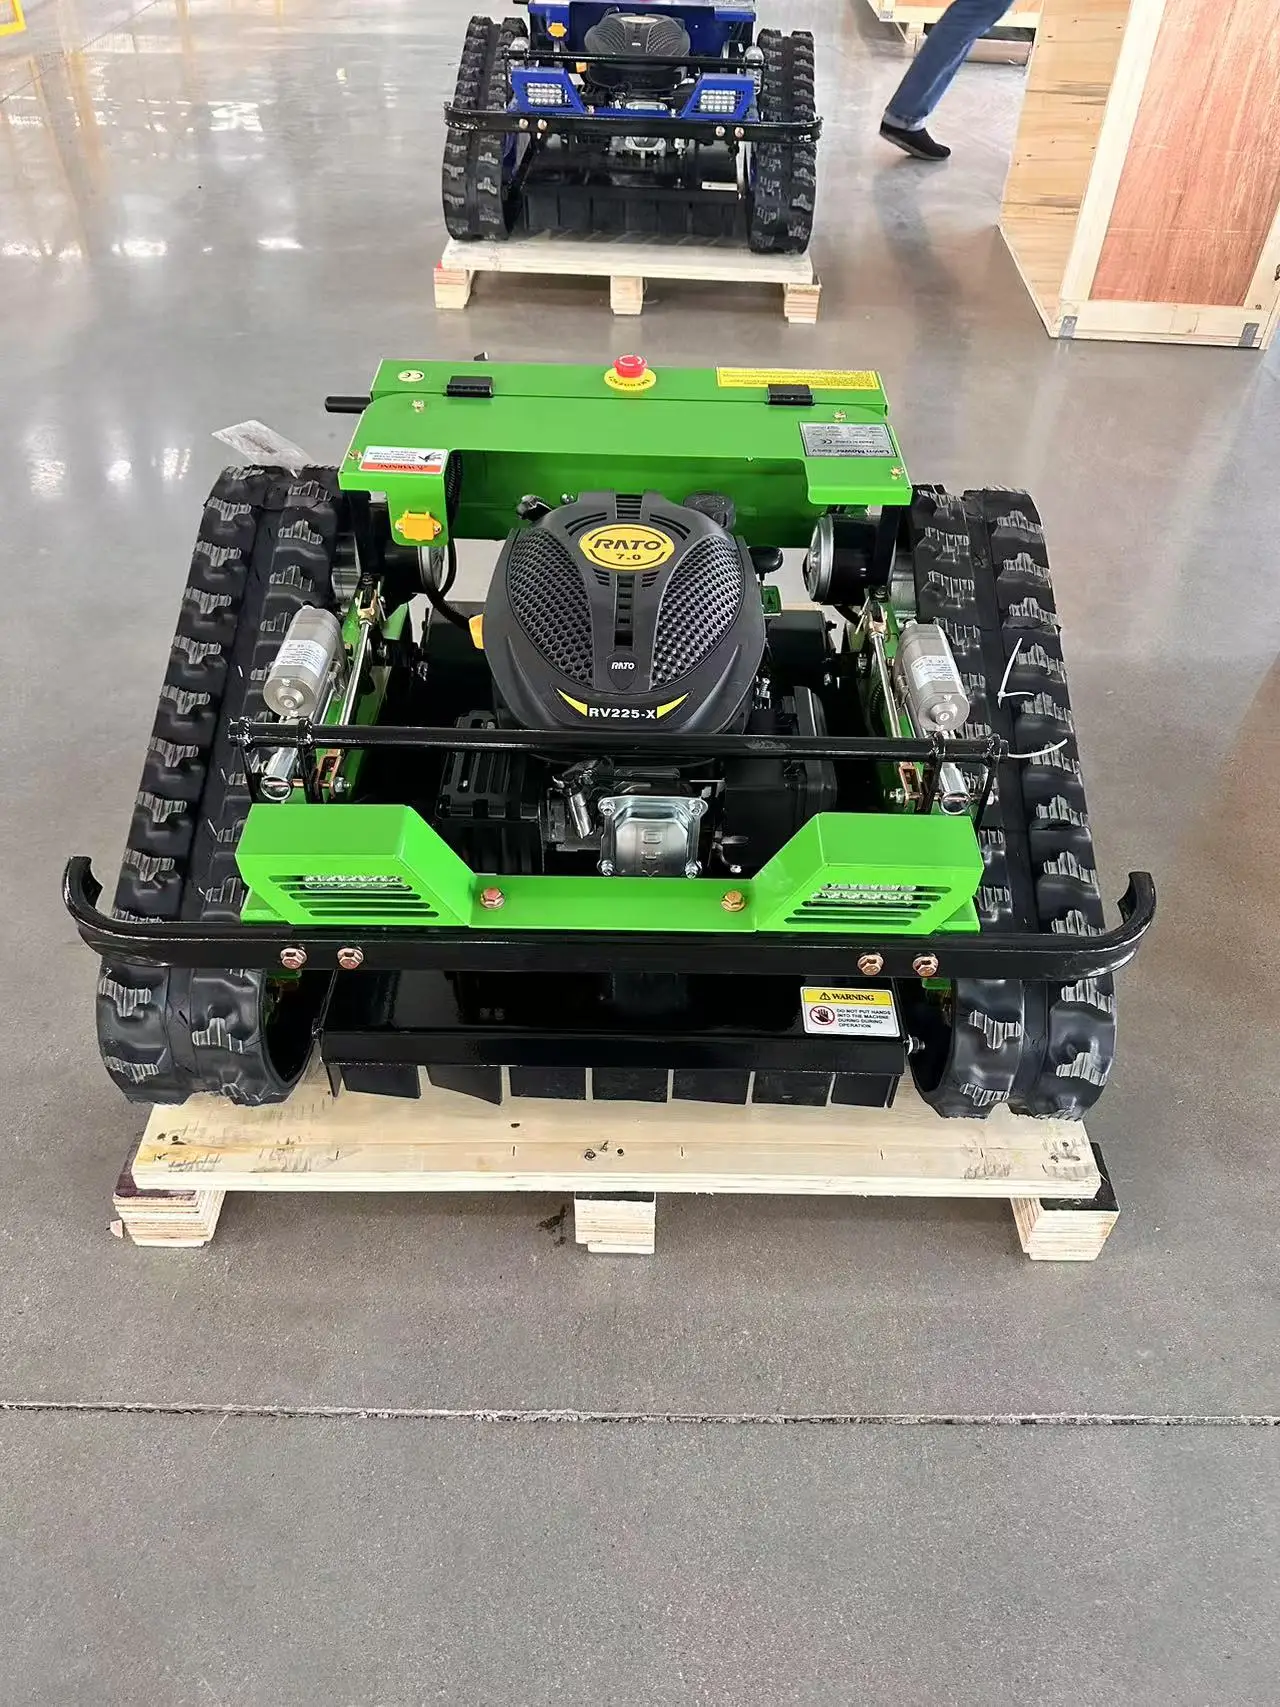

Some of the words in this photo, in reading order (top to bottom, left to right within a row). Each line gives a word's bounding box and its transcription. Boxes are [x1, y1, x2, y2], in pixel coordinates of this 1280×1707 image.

[594, 539, 661, 551] RATO
[616, 552, 642, 561] 7.0
[611, 661, 635, 670] RATO
[588, 707, 657, 719] RV225-X
[832, 993, 874, 1001] WARNING
